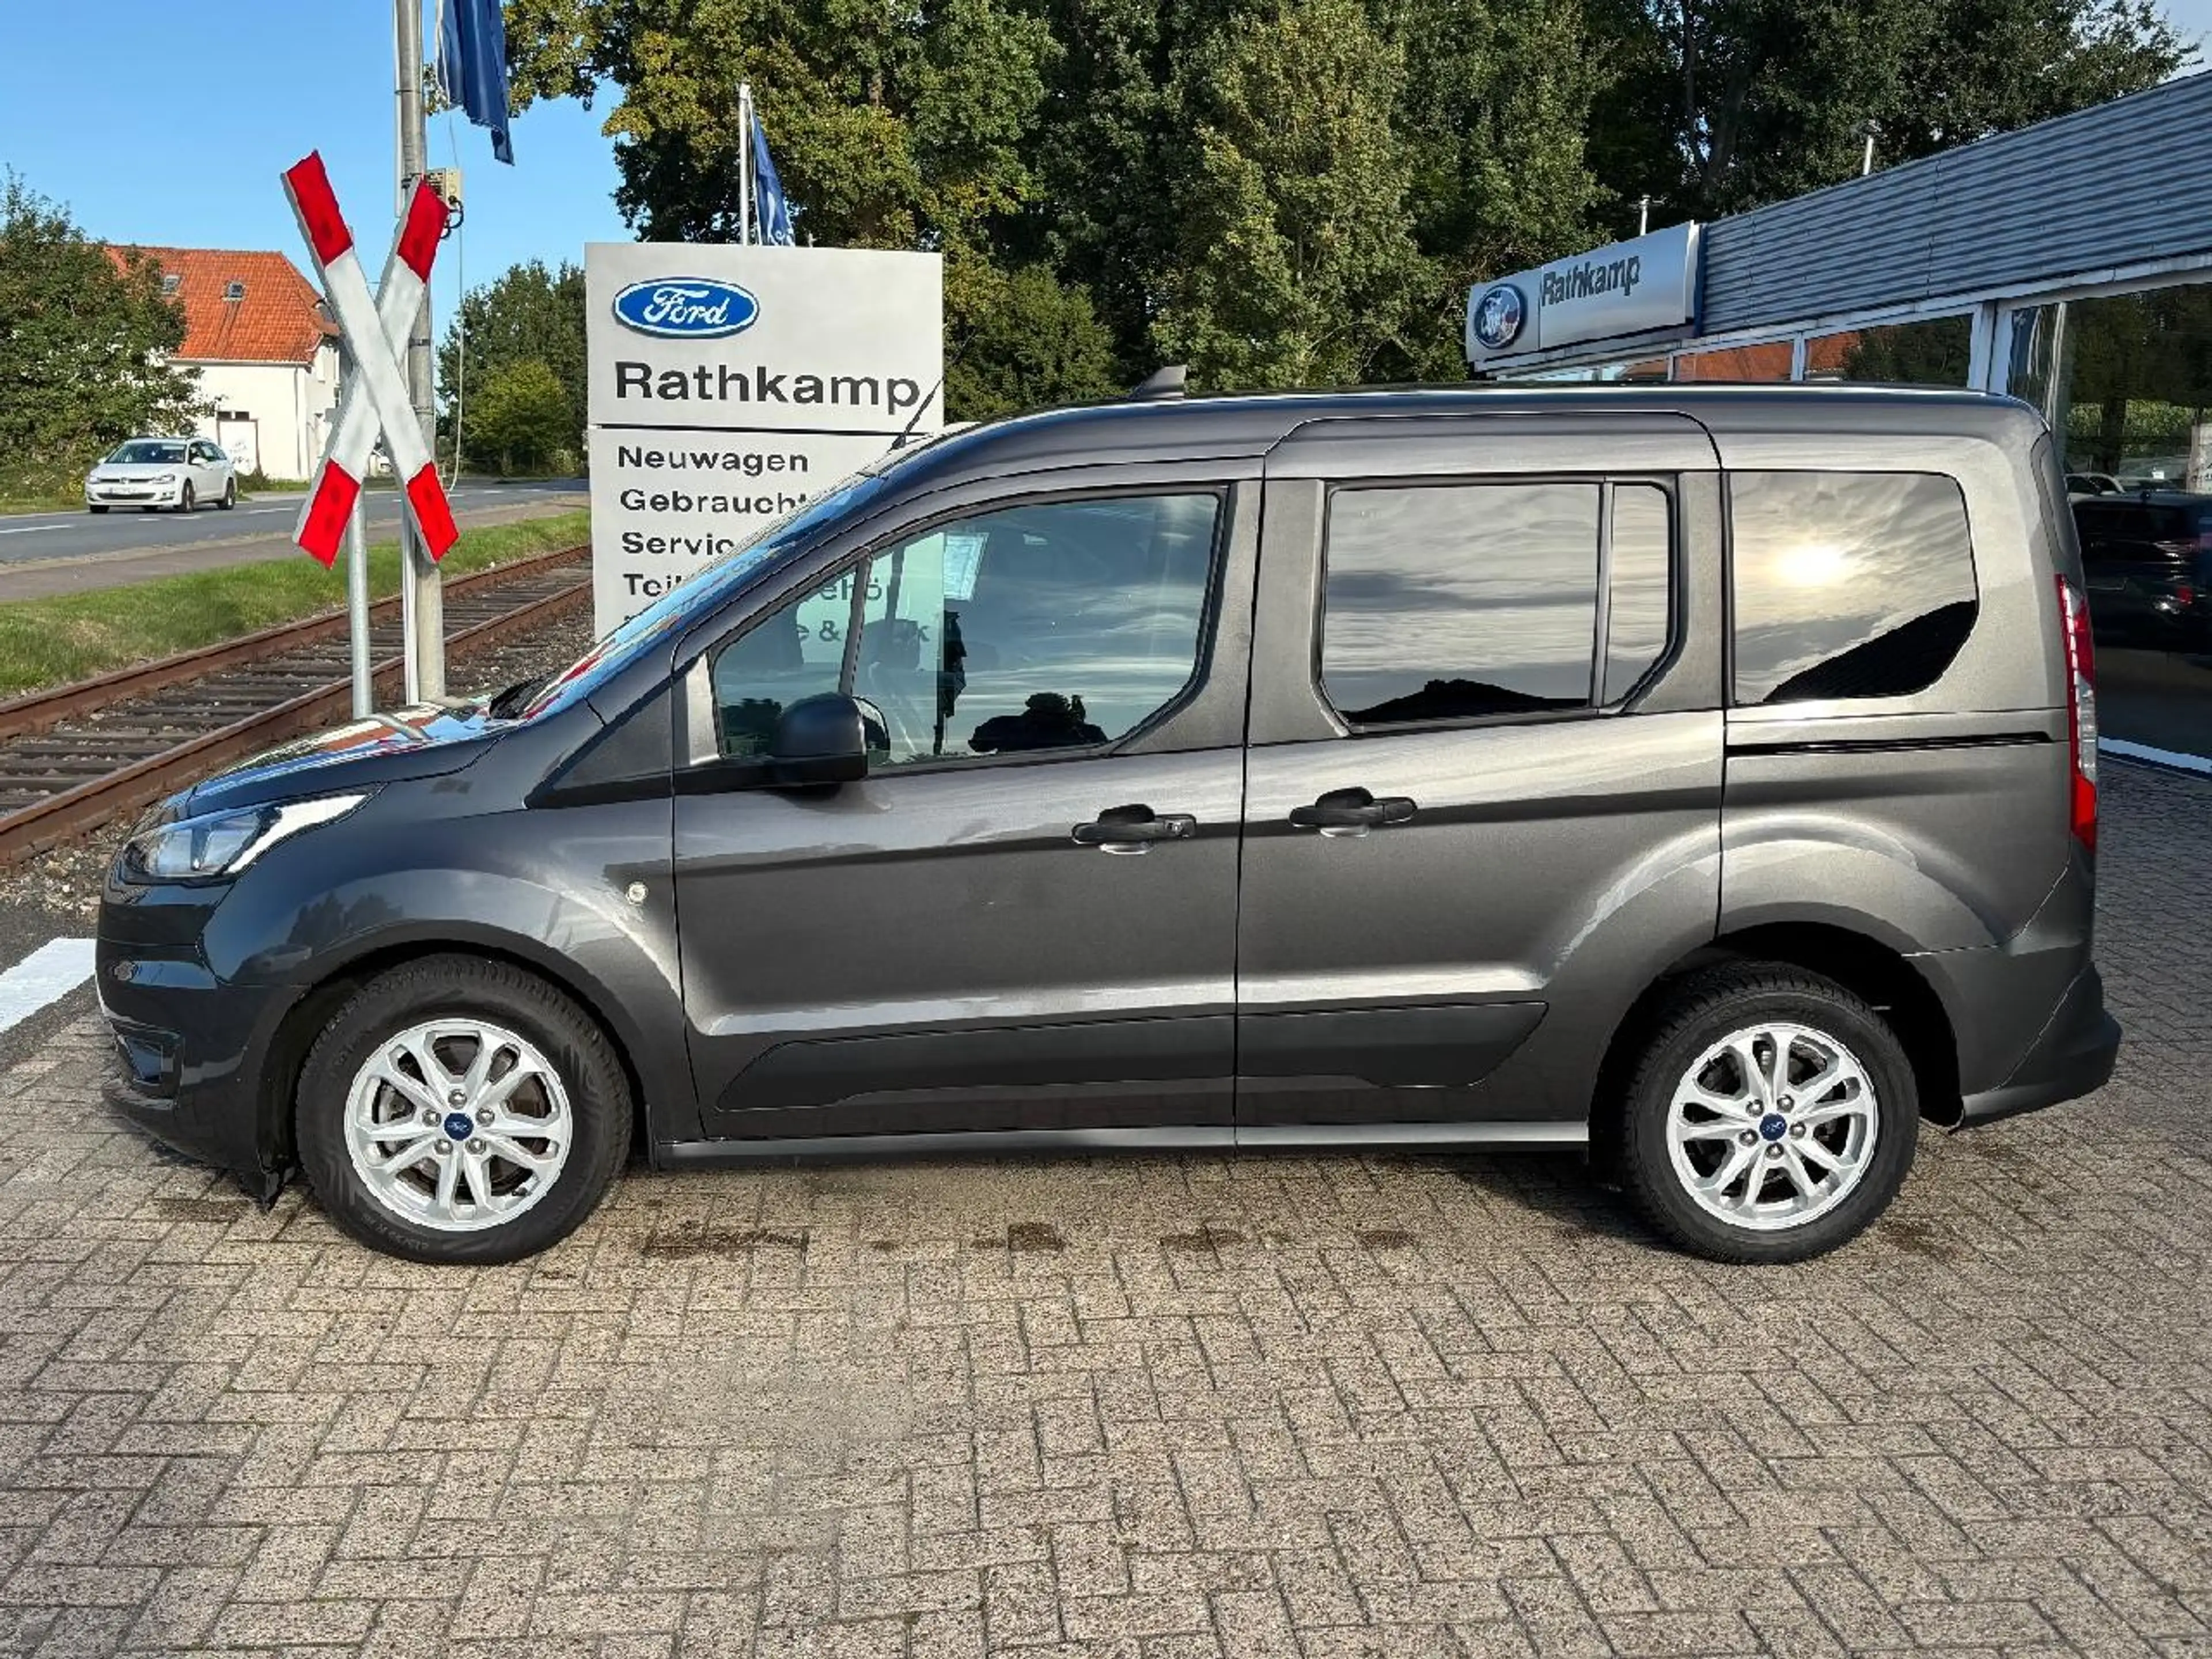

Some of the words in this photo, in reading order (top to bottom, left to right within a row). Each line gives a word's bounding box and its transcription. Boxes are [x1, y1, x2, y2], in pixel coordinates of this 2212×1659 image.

[1541, 255, 1640, 306] Rathkamp
[643, 287, 730, 324] Ford
[615, 361, 920, 415] Rathkamp
[618, 446, 808, 476] Neuwagen
